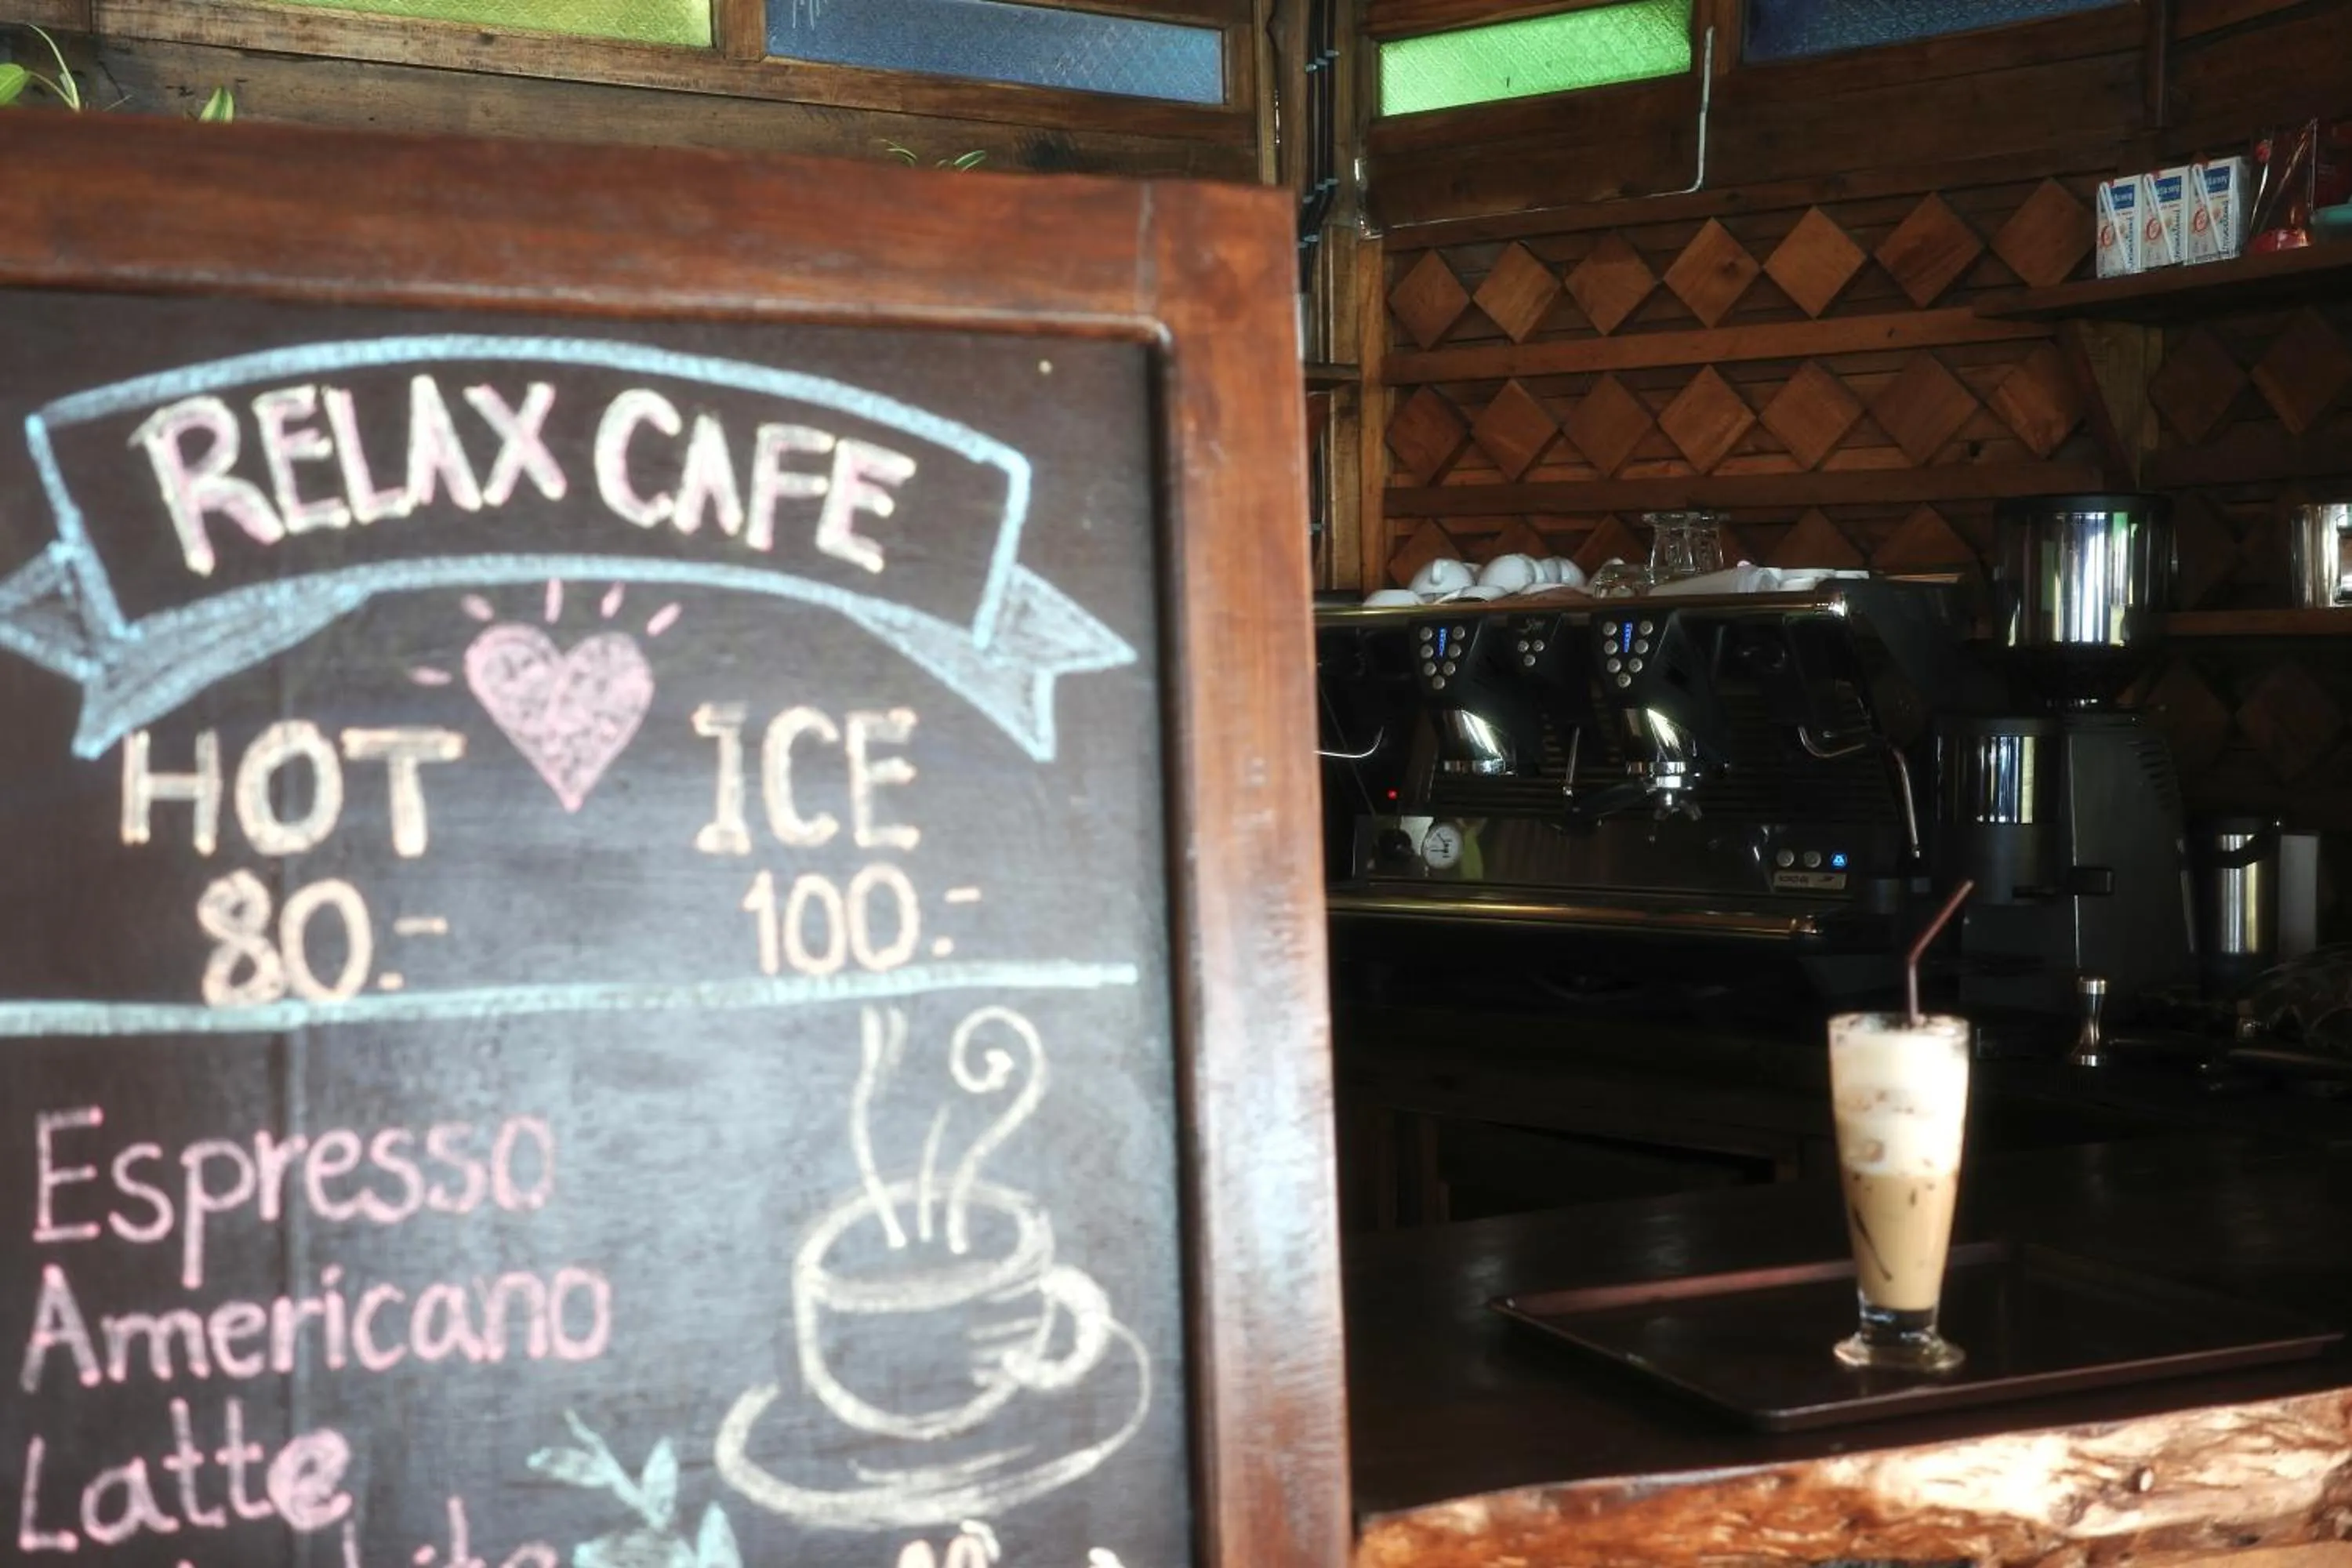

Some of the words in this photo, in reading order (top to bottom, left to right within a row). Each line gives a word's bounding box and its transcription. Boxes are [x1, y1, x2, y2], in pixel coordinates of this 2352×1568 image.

[128, 374, 567, 576] RELAX
[594, 389, 916, 572] CAFE
[121, 719, 466, 858] HOT
[691, 702, 920, 856] ICE
[32, 1105, 555, 1289] Espresso
[20, 1264, 612, 1392] Americano
[17, 1398, 353, 1552] Latte
